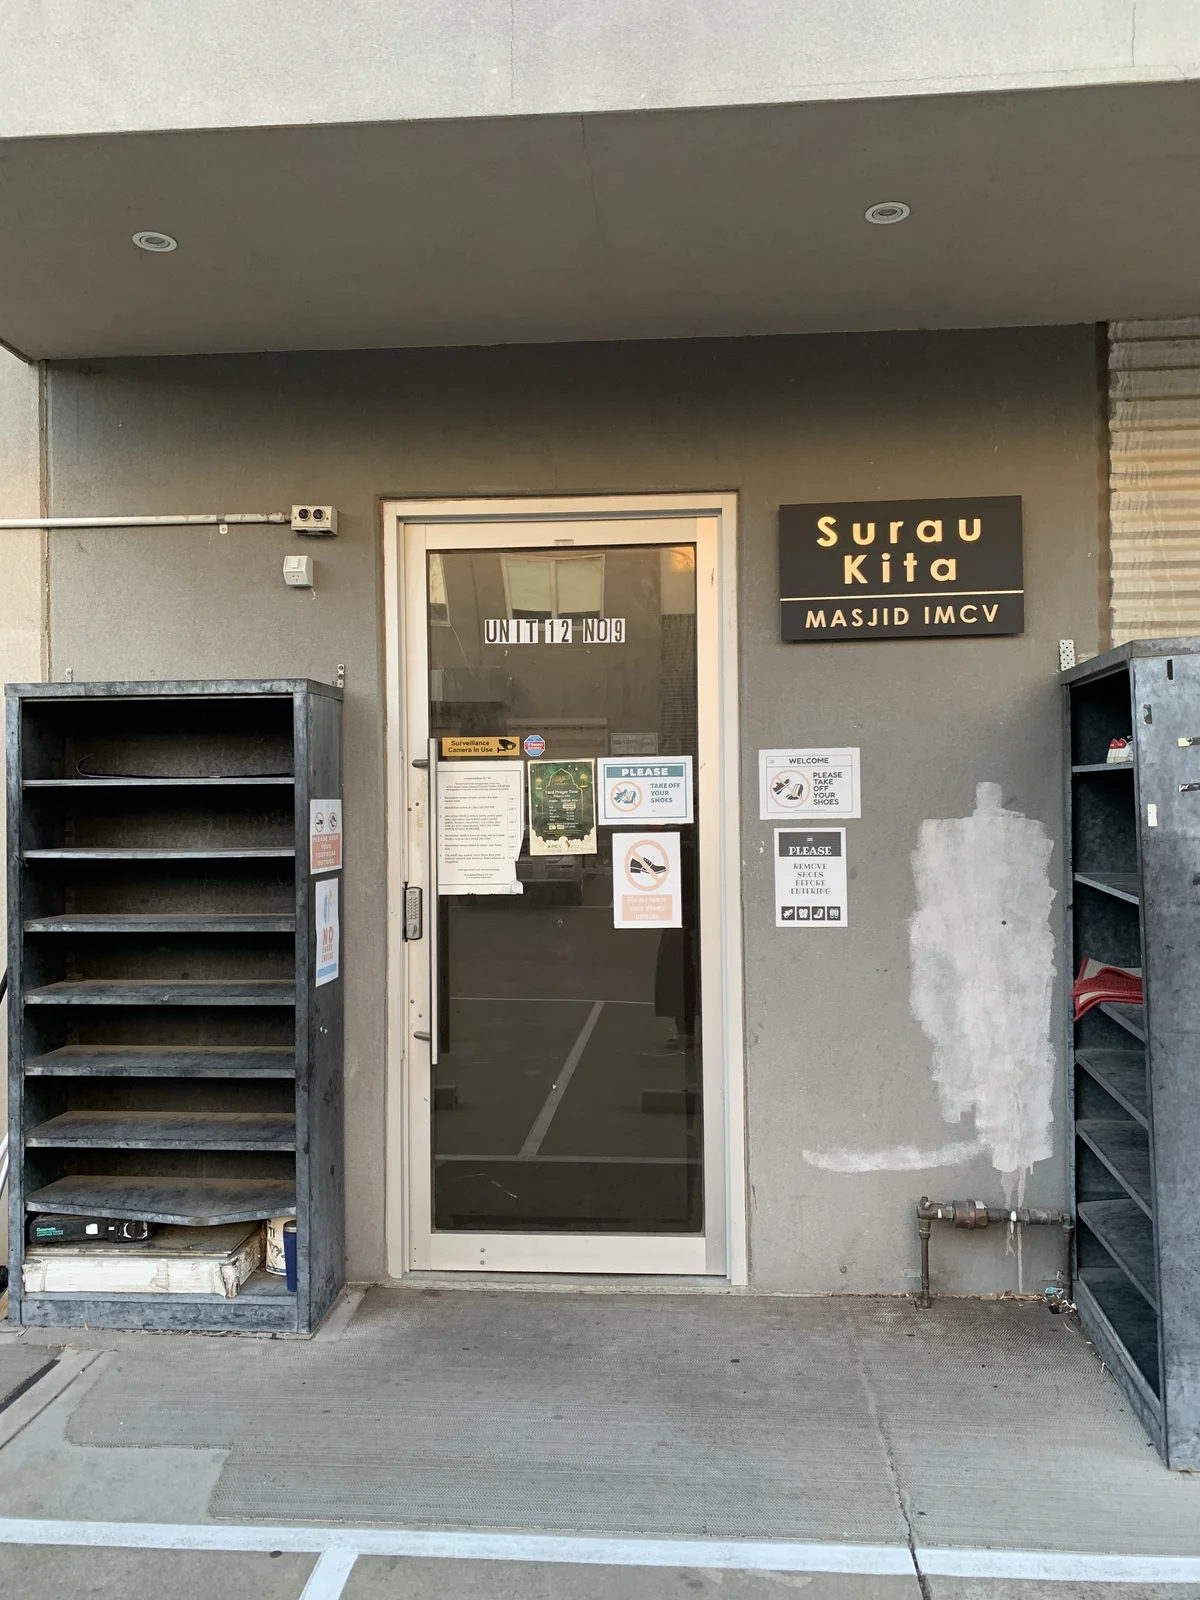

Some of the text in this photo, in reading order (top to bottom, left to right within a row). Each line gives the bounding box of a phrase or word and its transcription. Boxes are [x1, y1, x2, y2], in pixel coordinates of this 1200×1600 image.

[816, 516, 981, 547] Surau
[844, 552, 957, 584] Kita
[805, 604, 999, 629] MASJID IMCV
[485, 619, 537, 643] UNIT
[548, 619, 570, 643] 12
[451, 739, 490, 747] Surveillance
[447, 746, 472, 754] Camera
[789, 757, 830, 765] WELCOME
[621, 767, 669, 777] PLEASE
[812, 771, 843, 779] PLEASE
[650, 782, 668, 790] TAKE
[813, 778, 834, 786] TAKE
[813, 791, 836, 799] YOUR
[813, 798, 840, 806] SHOES
[789, 846, 832, 856] PLEASE
[790, 887, 831, 895] ENTERING
[322, 925, 334, 946] NO
